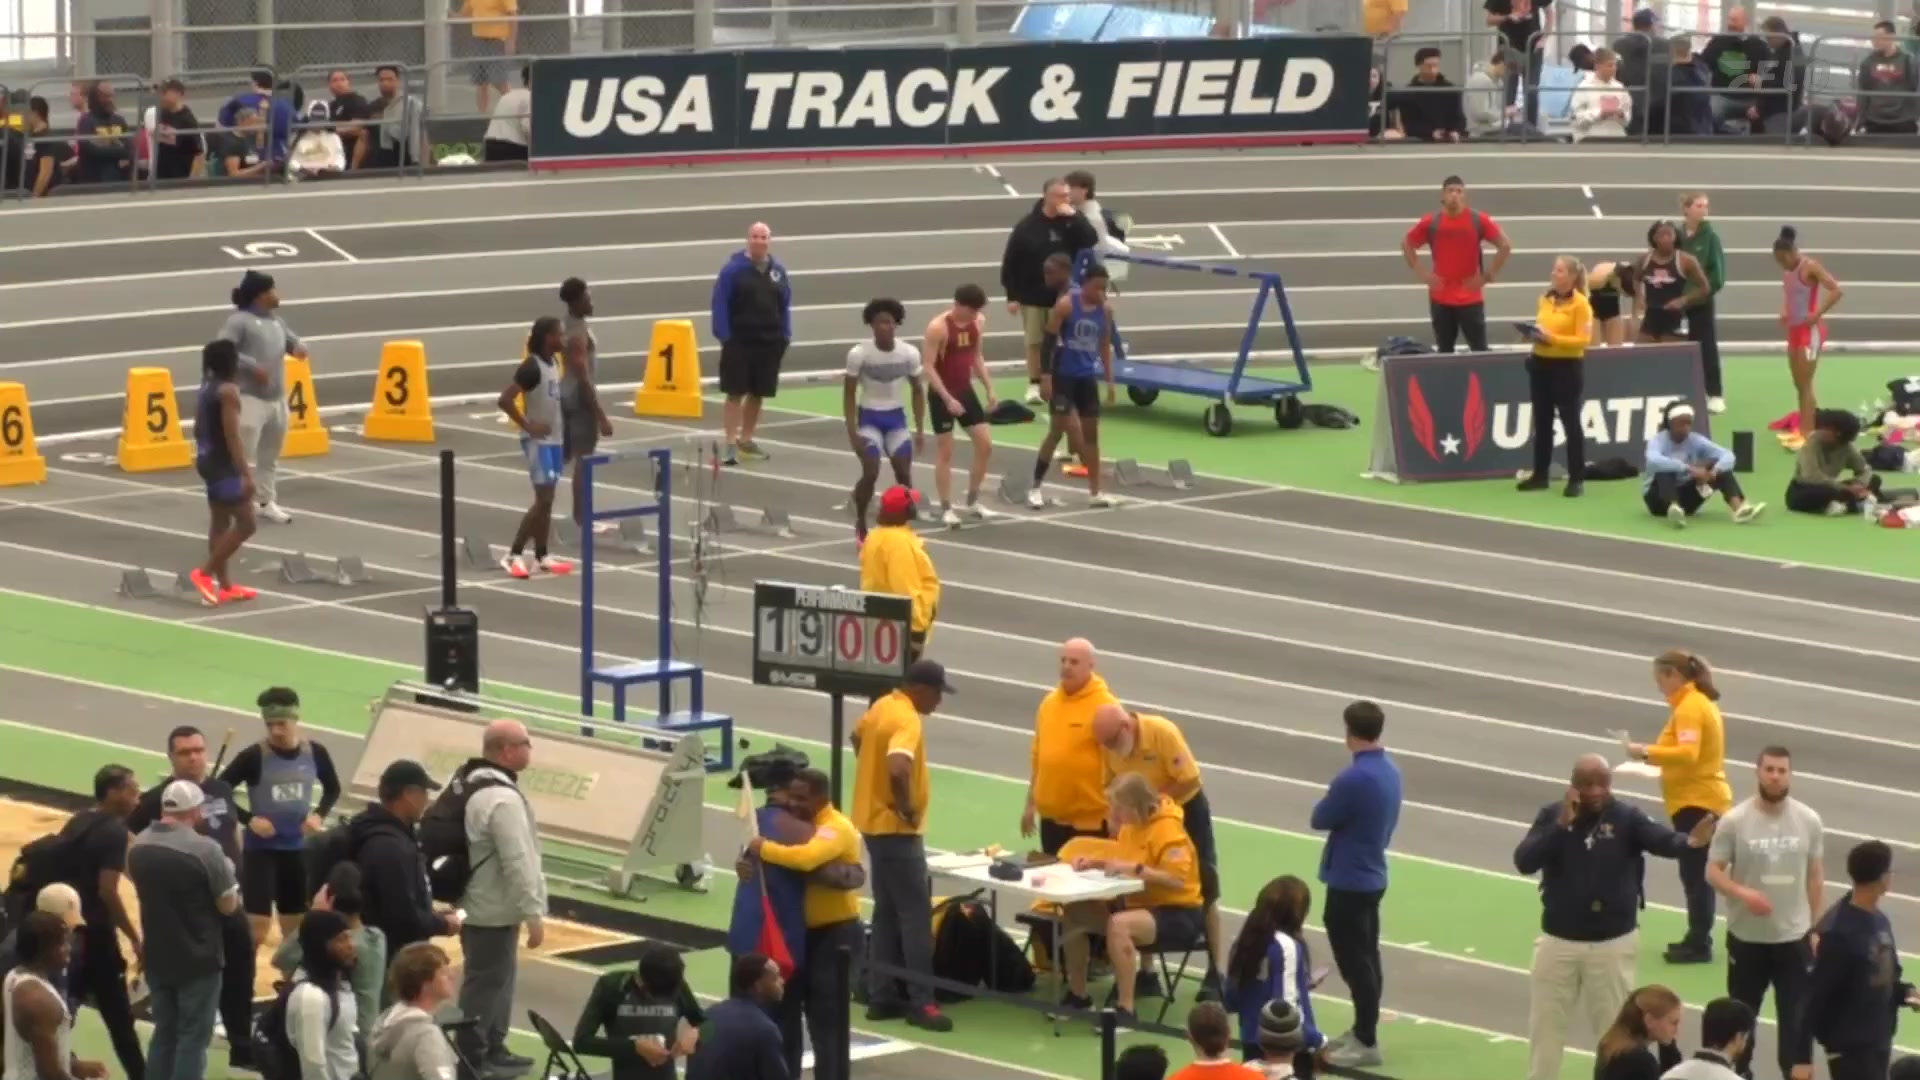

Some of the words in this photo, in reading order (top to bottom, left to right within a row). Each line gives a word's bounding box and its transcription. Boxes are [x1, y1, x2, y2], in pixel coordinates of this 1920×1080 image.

[562, 74, 713, 138] USA
[744, 66, 1010, 131] TRACK
[1029, 63, 1083, 122] &
[1106, 57, 1335, 120] FIELD
[658, 343, 674, 382] 1
[287, 380, 308, 421] 4
[385, 365, 409, 407] 3
[1, 404, 24, 447] 6
[146, 391, 169, 433] 5
